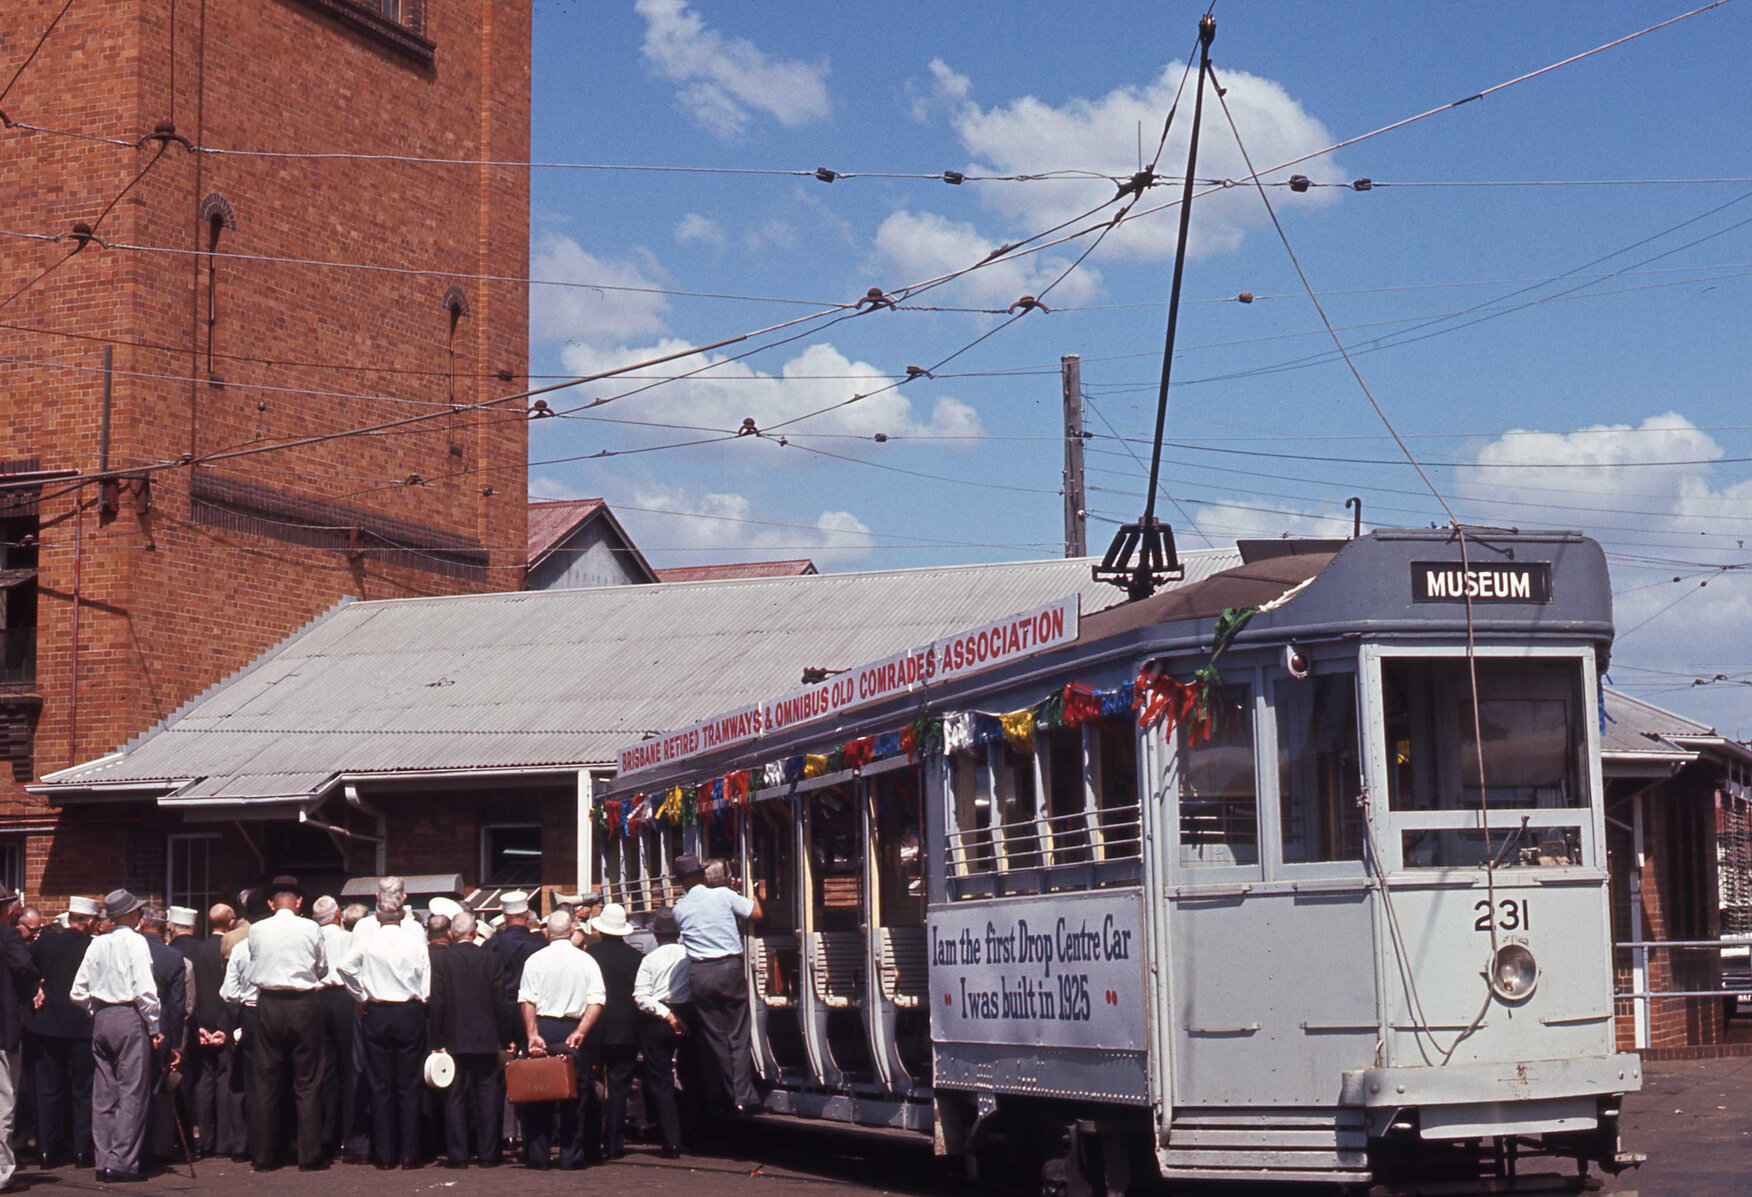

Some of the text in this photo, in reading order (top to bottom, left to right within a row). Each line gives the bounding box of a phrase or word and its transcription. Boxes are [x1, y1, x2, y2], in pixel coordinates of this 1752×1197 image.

[1426, 570, 1531, 598] MUSEUM
[622, 607, 1064, 772] BRISBANE RETIRED TRAMWAYS & OMNIBUS OLD COMRADES ASSOCIATION
[1474, 899, 1529, 931] 231
[932, 914, 1131, 977] I am the first Drop Centre Car
[960, 974, 1091, 1021] I was built in 1925
